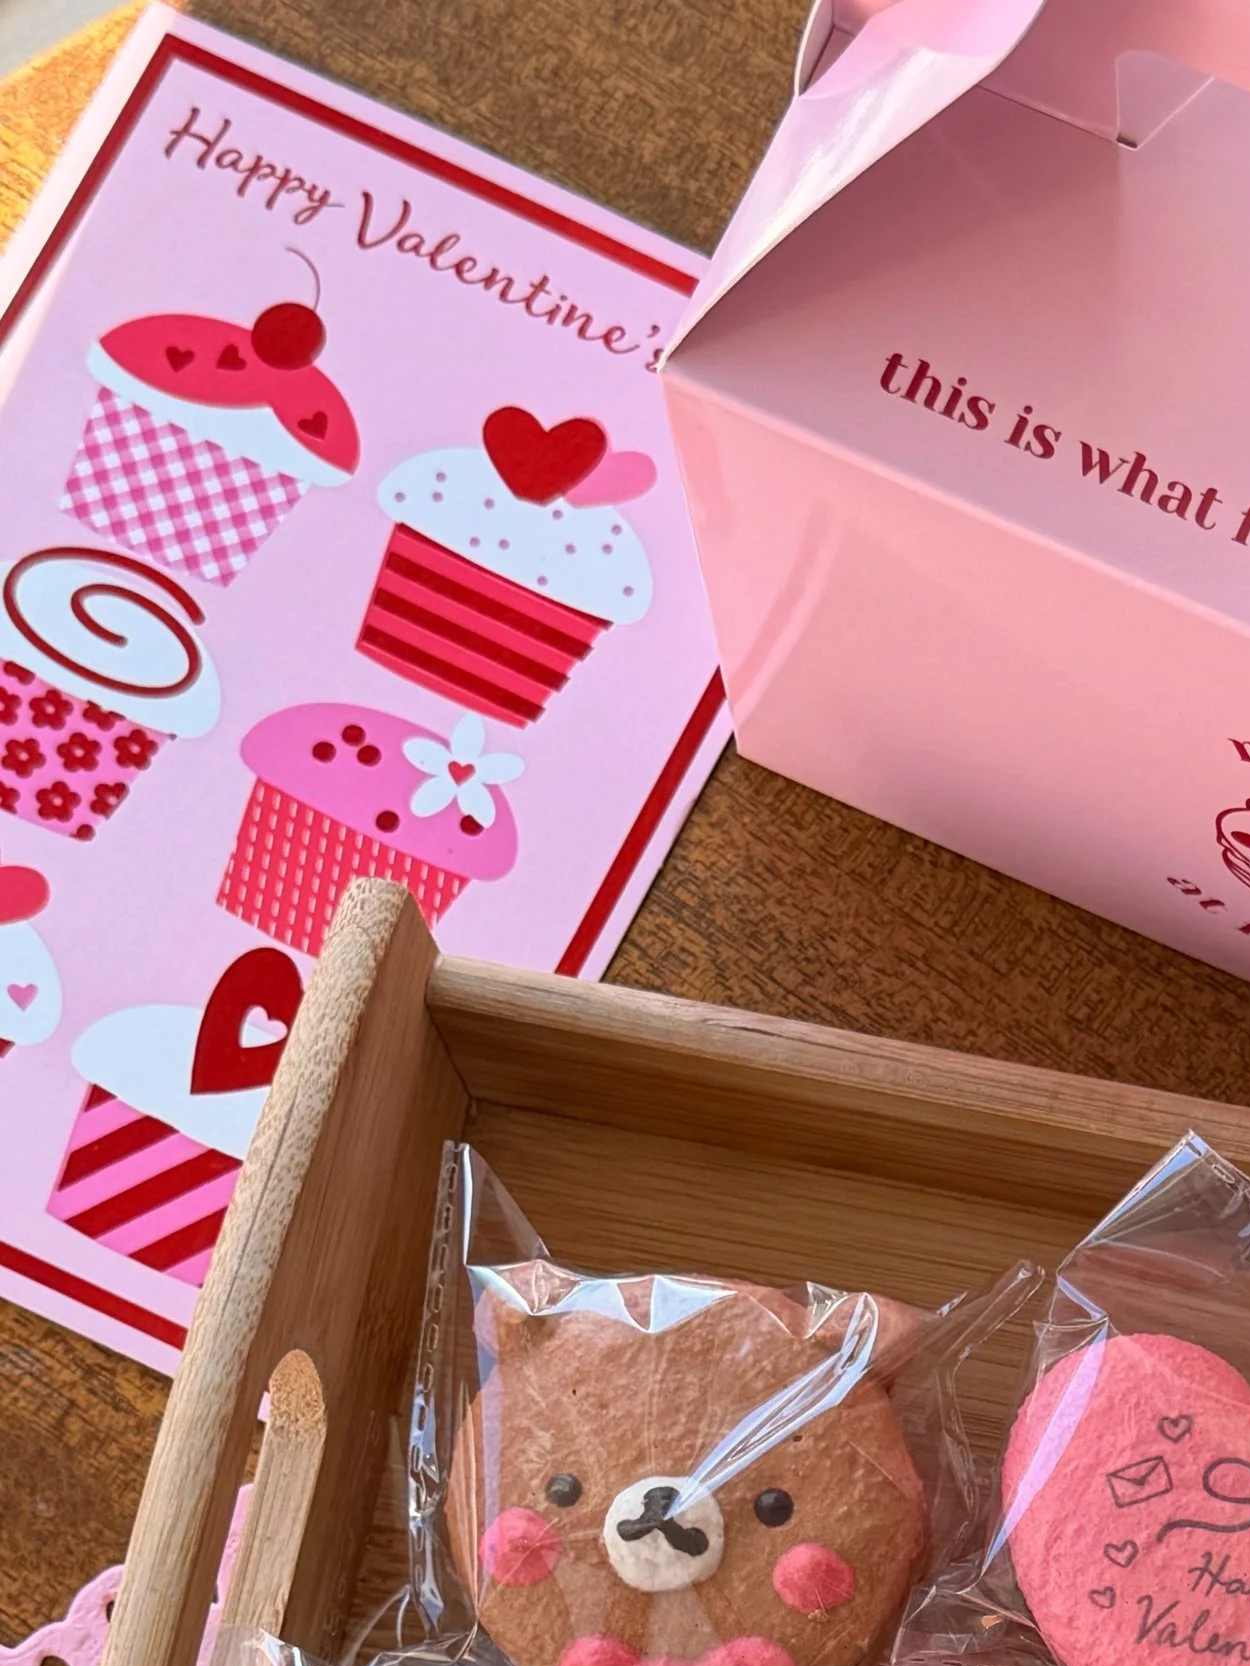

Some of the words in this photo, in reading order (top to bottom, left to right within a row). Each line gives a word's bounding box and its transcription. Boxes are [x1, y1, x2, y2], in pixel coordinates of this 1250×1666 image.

[164, 106, 345, 225] Happy
[879, 352, 996, 432] this
[1004, 405, 1062, 460] is
[1079, 440, 1224, 531] what
